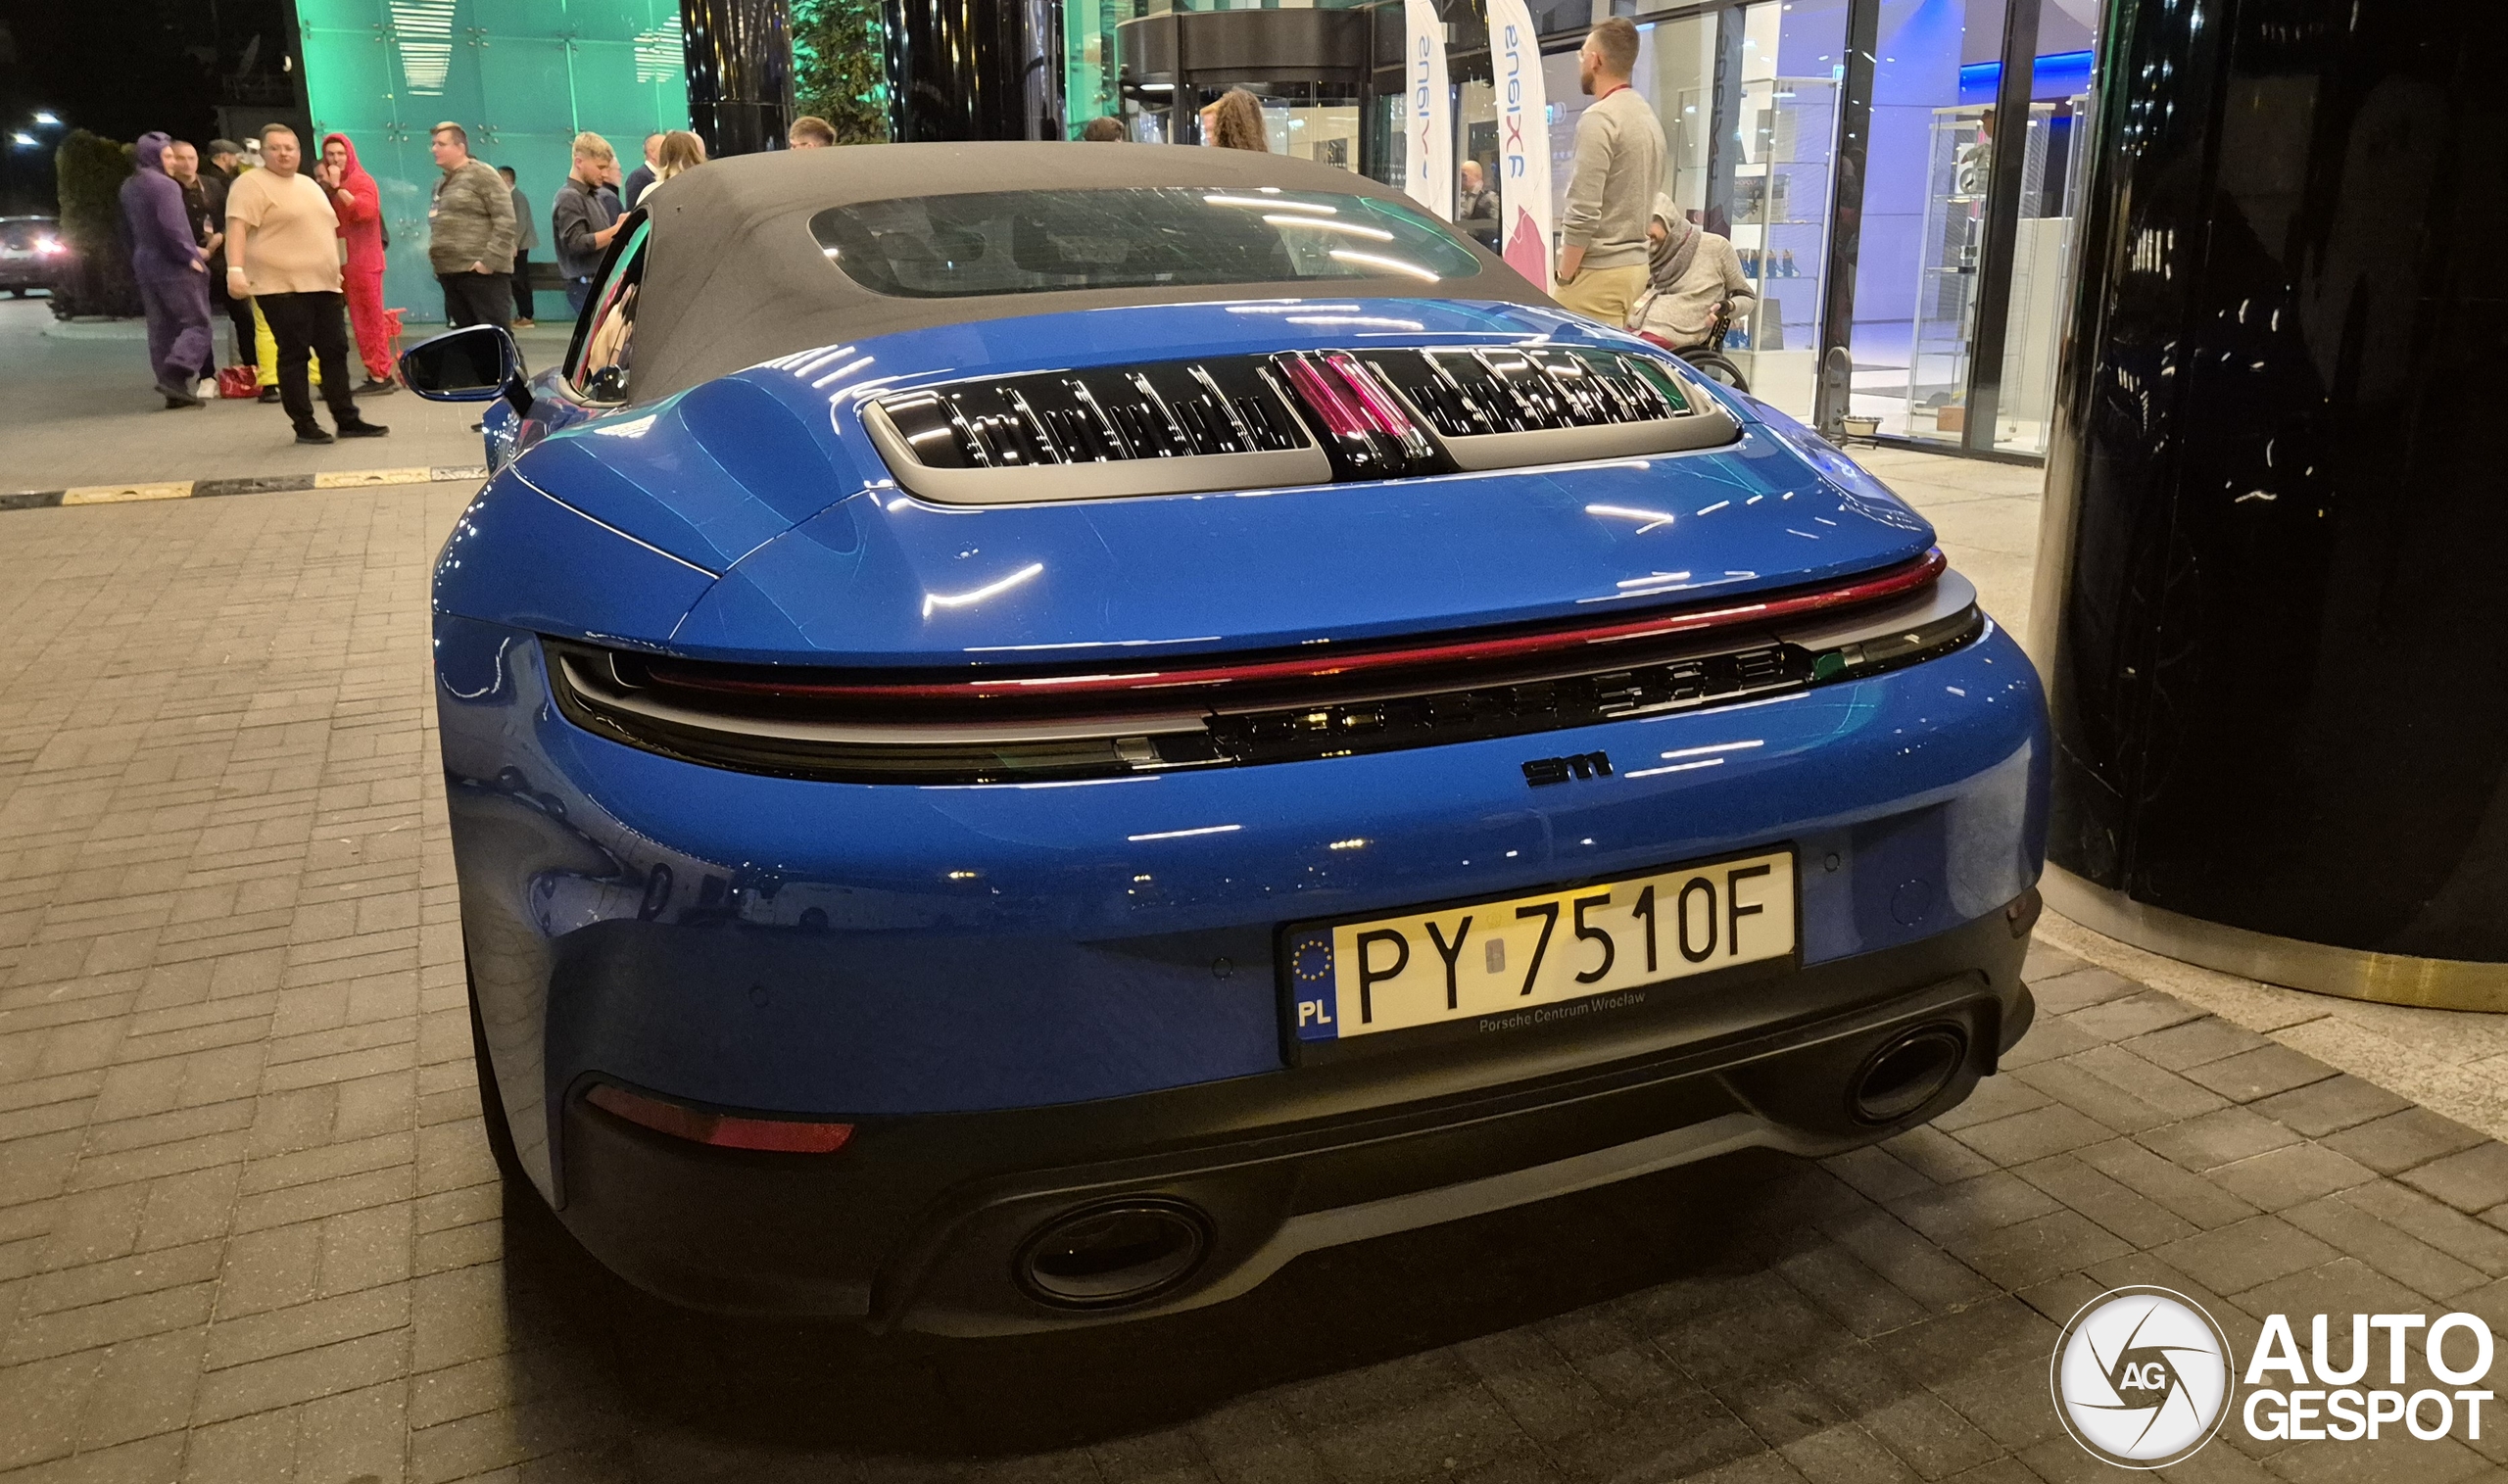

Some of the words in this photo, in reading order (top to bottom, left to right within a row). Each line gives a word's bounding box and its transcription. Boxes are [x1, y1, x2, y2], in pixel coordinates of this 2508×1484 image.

[1356, 915, 1473, 1024] PY
[1515, 864, 1771, 997] 7510F
[1298, 999, 1331, 1028] PL
[1479, 1013, 1531, 1032] Porsche
[1534, 1002, 1589, 1024] Centrum
